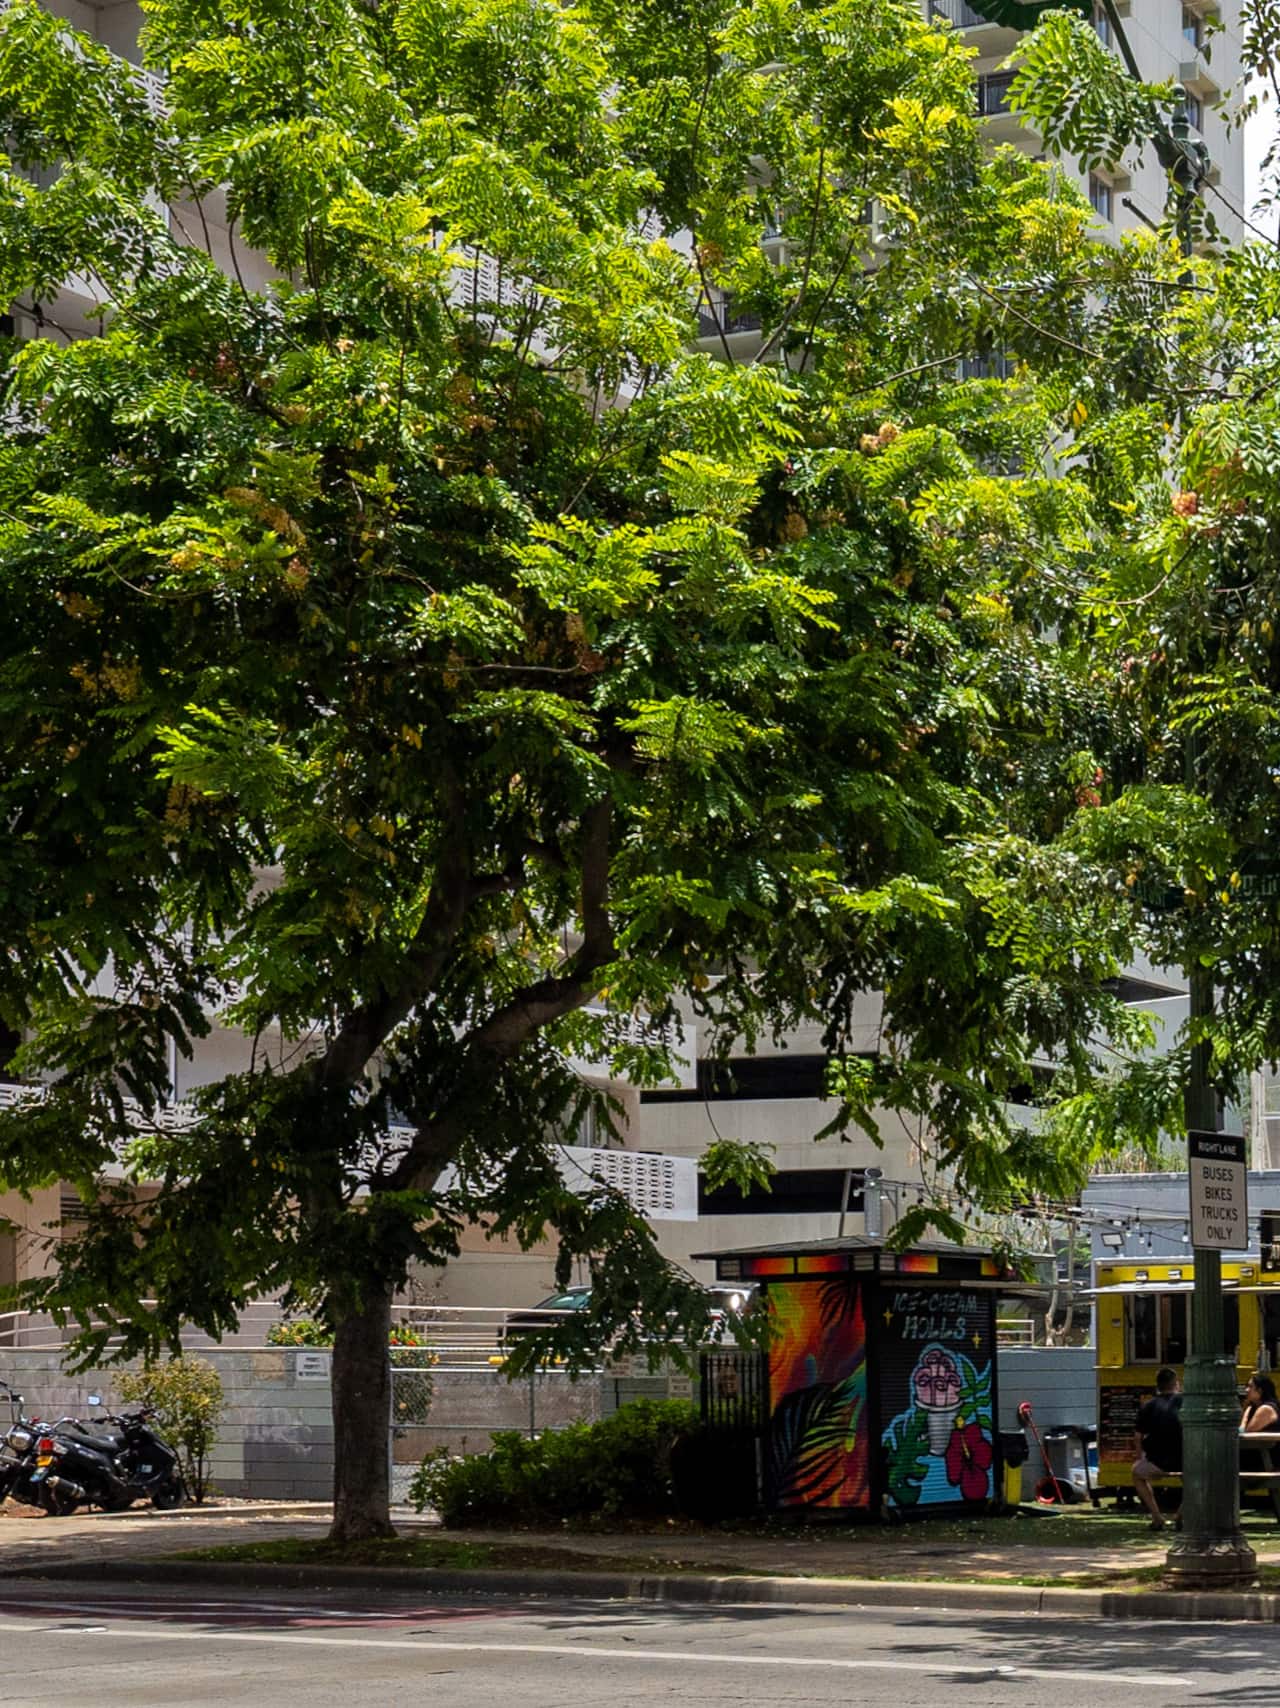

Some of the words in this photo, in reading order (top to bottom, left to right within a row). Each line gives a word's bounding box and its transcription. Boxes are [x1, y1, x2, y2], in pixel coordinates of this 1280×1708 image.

[1198, 1141, 1218, 1154] RIGHT
[1219, 1144, 1237, 1156] LANE
[1203, 1165, 1234, 1181] BUSES
[1205, 1186, 1233, 1201] BIKES
[1200, 1205, 1239, 1221] TRUCKS
[1207, 1225, 1233, 1240] ONLY
